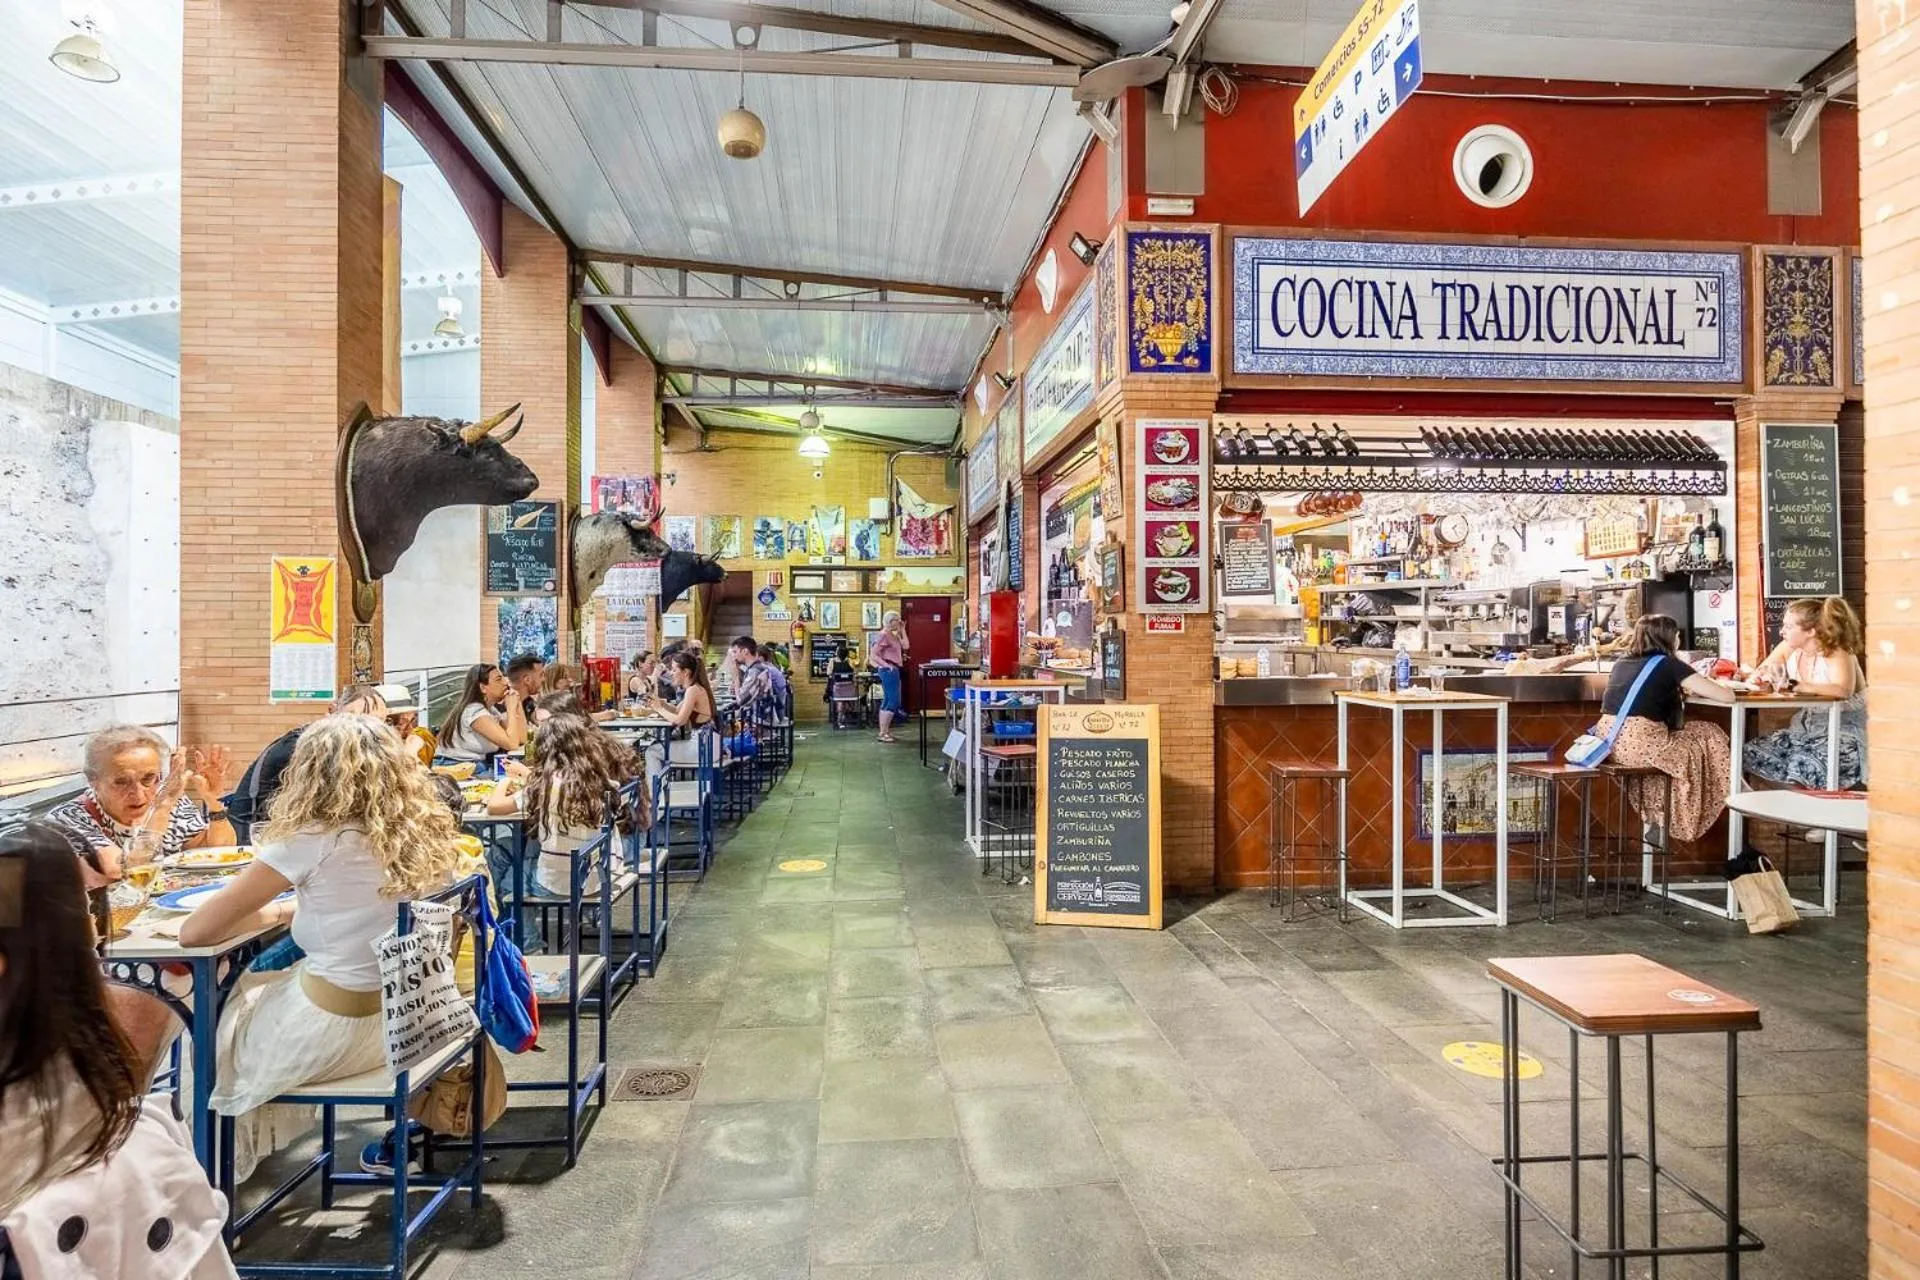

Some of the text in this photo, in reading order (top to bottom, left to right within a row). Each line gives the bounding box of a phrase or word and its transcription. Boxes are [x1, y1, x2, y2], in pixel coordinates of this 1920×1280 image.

[1314, 38, 1357, 99] Comercios
[1271, 274, 1685, 349] COCINA TRADICIONAL
[1696, 307, 1717, 328] 72
[1095, 770, 1136, 778] CASEROS
[1098, 780, 1133, 790] VARIOS
[1058, 794, 1095, 803] CARNES
[1111, 808, 1142, 818] VARIOS
[1057, 851, 1112, 861] GAMBONES
